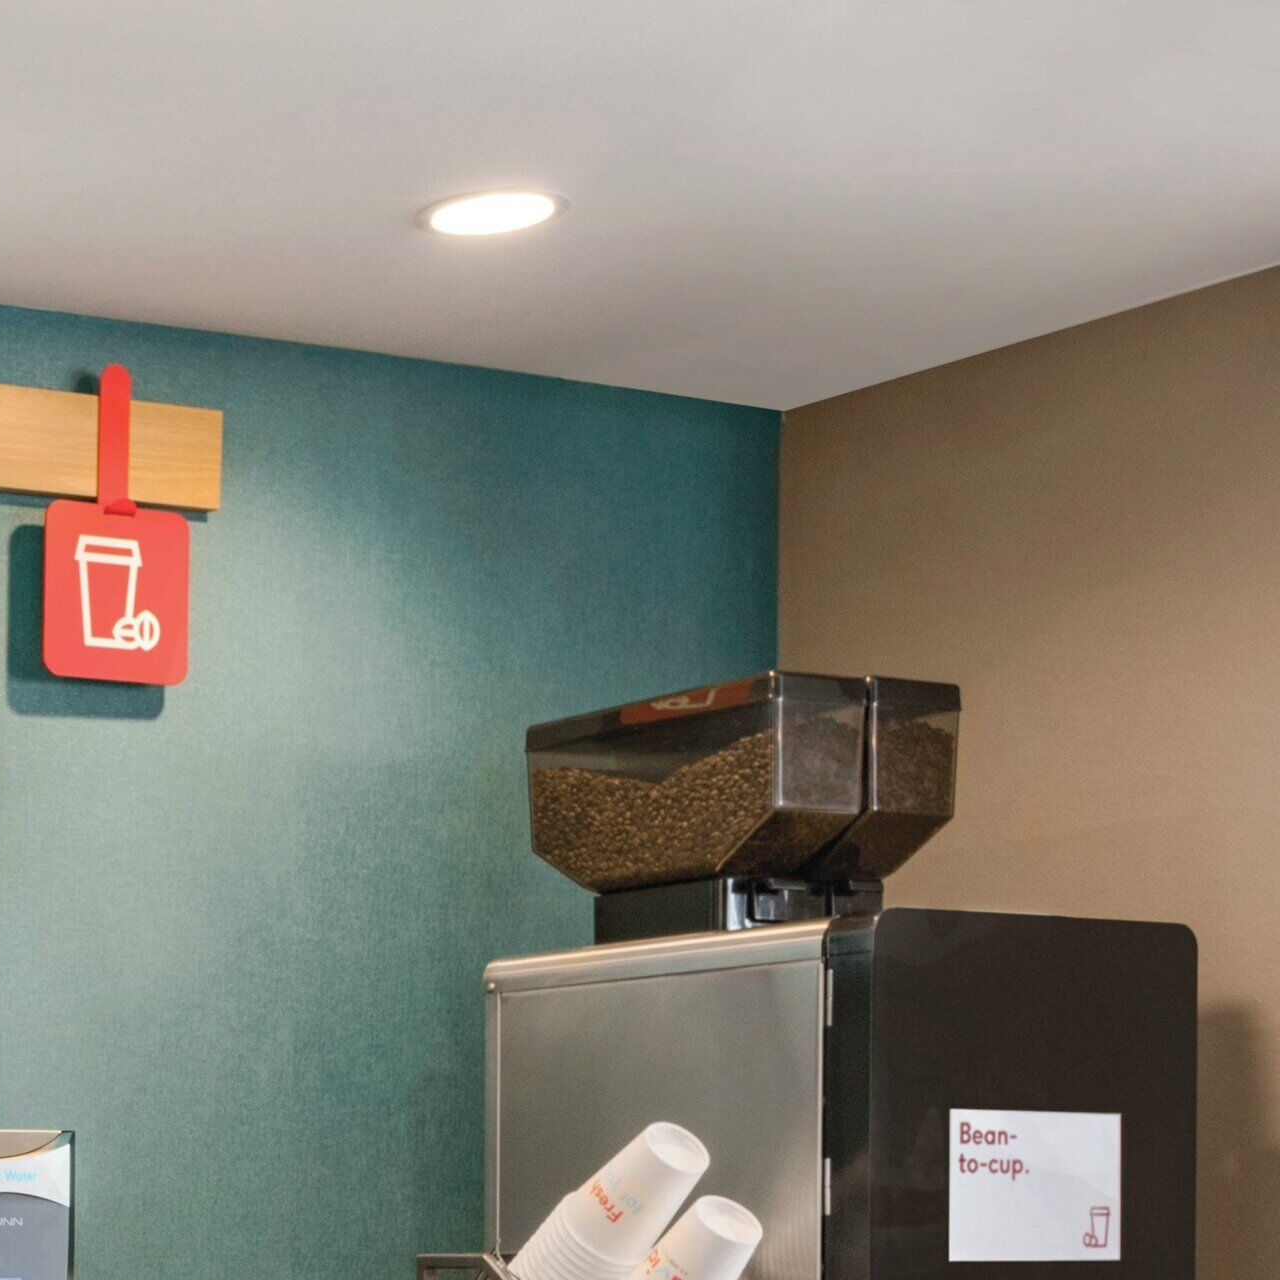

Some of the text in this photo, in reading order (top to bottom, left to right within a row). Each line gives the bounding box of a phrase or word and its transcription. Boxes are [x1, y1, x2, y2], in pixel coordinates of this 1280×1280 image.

[959, 1121, 1018, 1145] Bean-
[5, 1169, 37, 1181] Water
[958, 1153, 1030, 1181] to-cup.
